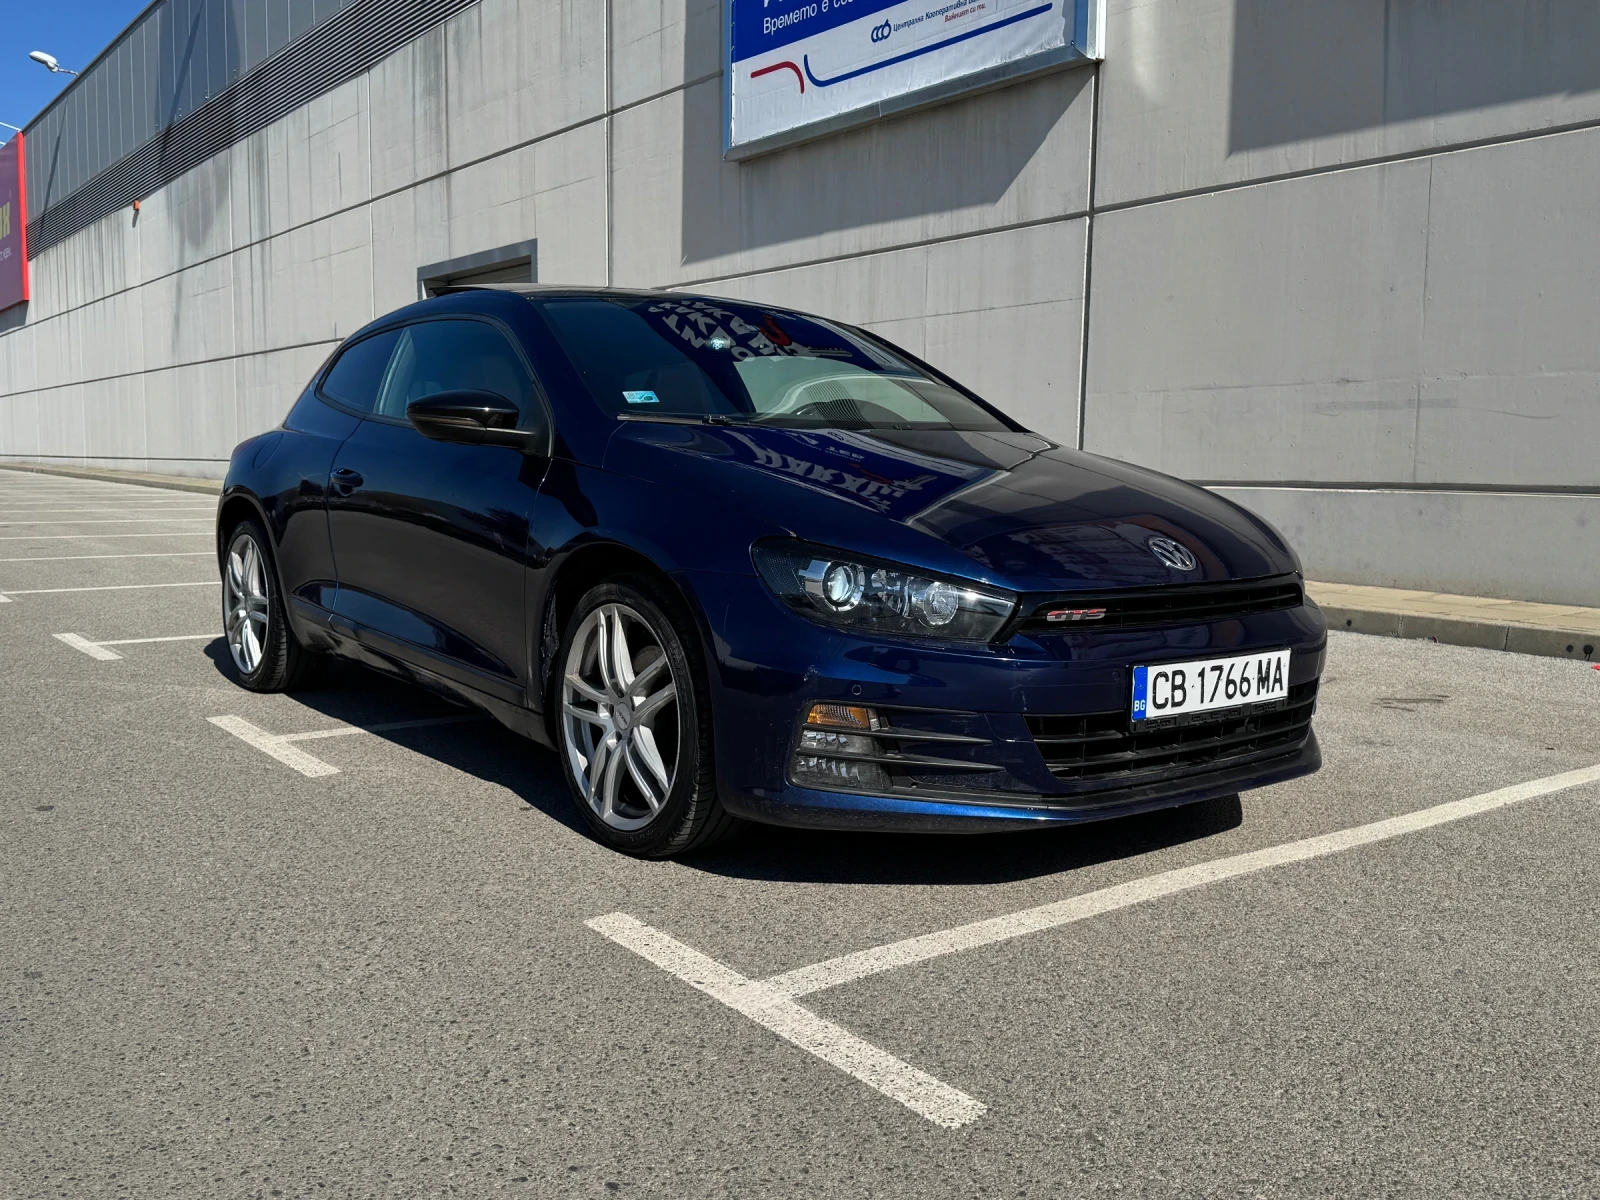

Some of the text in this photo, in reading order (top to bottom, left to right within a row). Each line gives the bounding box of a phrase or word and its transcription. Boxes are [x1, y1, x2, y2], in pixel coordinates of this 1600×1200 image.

[764, 3, 817, 35] Времето
[893, 0, 968, 32] Централна Кооперативна
[1046, 608, 1106, 622] GTS
[1152, 656, 1284, 710] CB 1766 MA
[1134, 699, 1146, 711] BG
